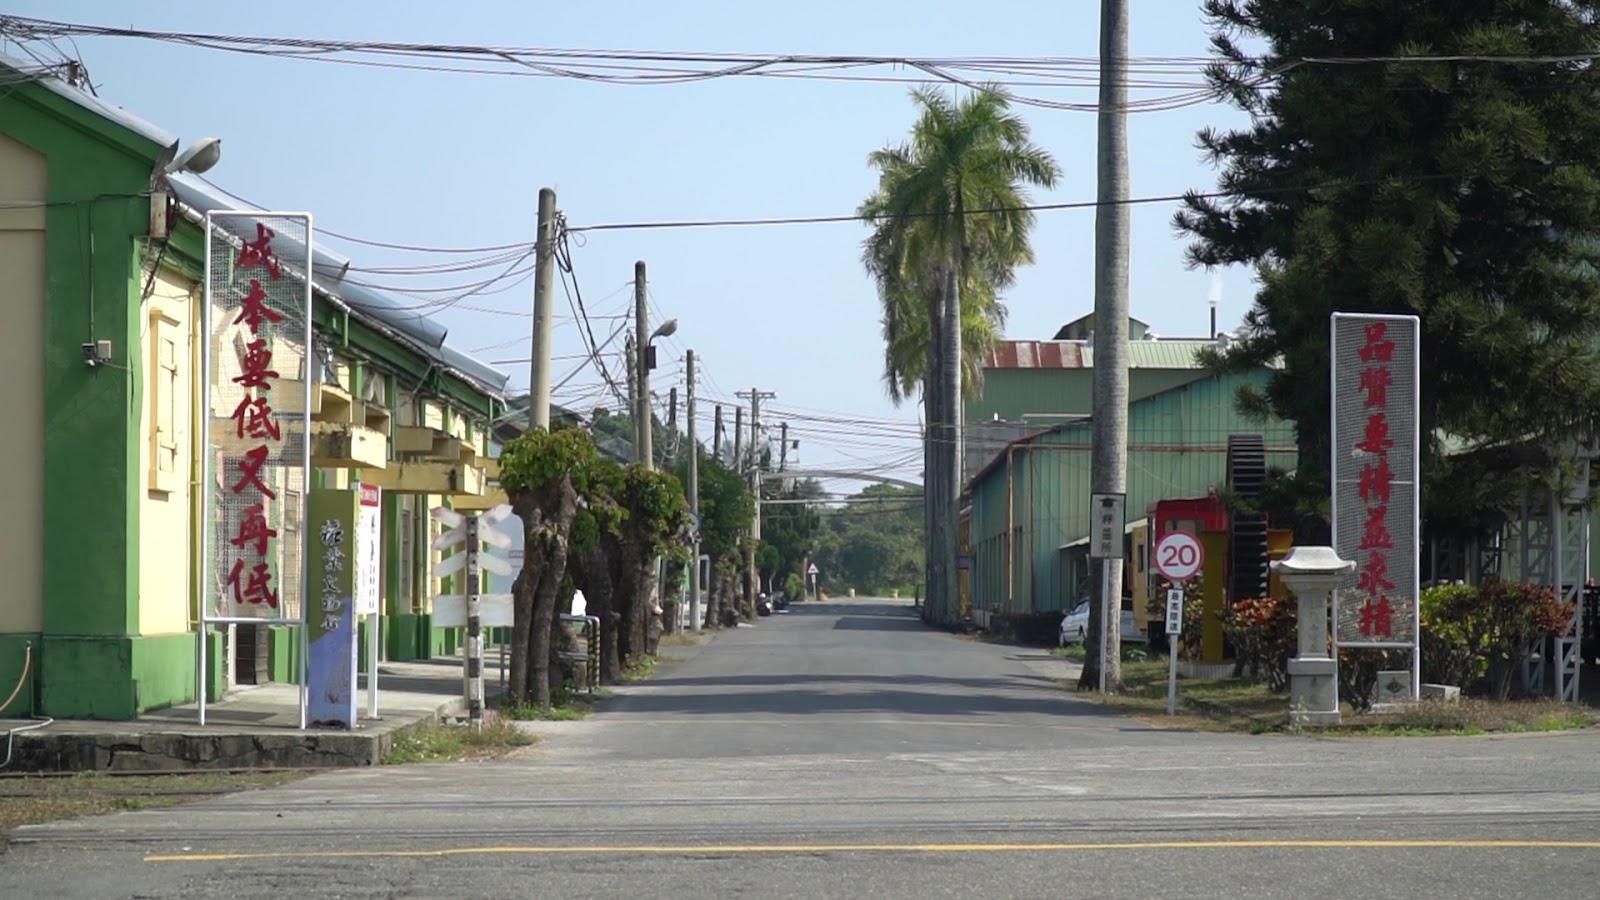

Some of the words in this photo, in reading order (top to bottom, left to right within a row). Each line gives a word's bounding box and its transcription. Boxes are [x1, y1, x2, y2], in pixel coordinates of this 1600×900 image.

[227, 222, 283, 609] 成本要低又再低
[1162, 545, 1197, 567] 20
[1354, 322, 1396, 638] 品質要精益求精
